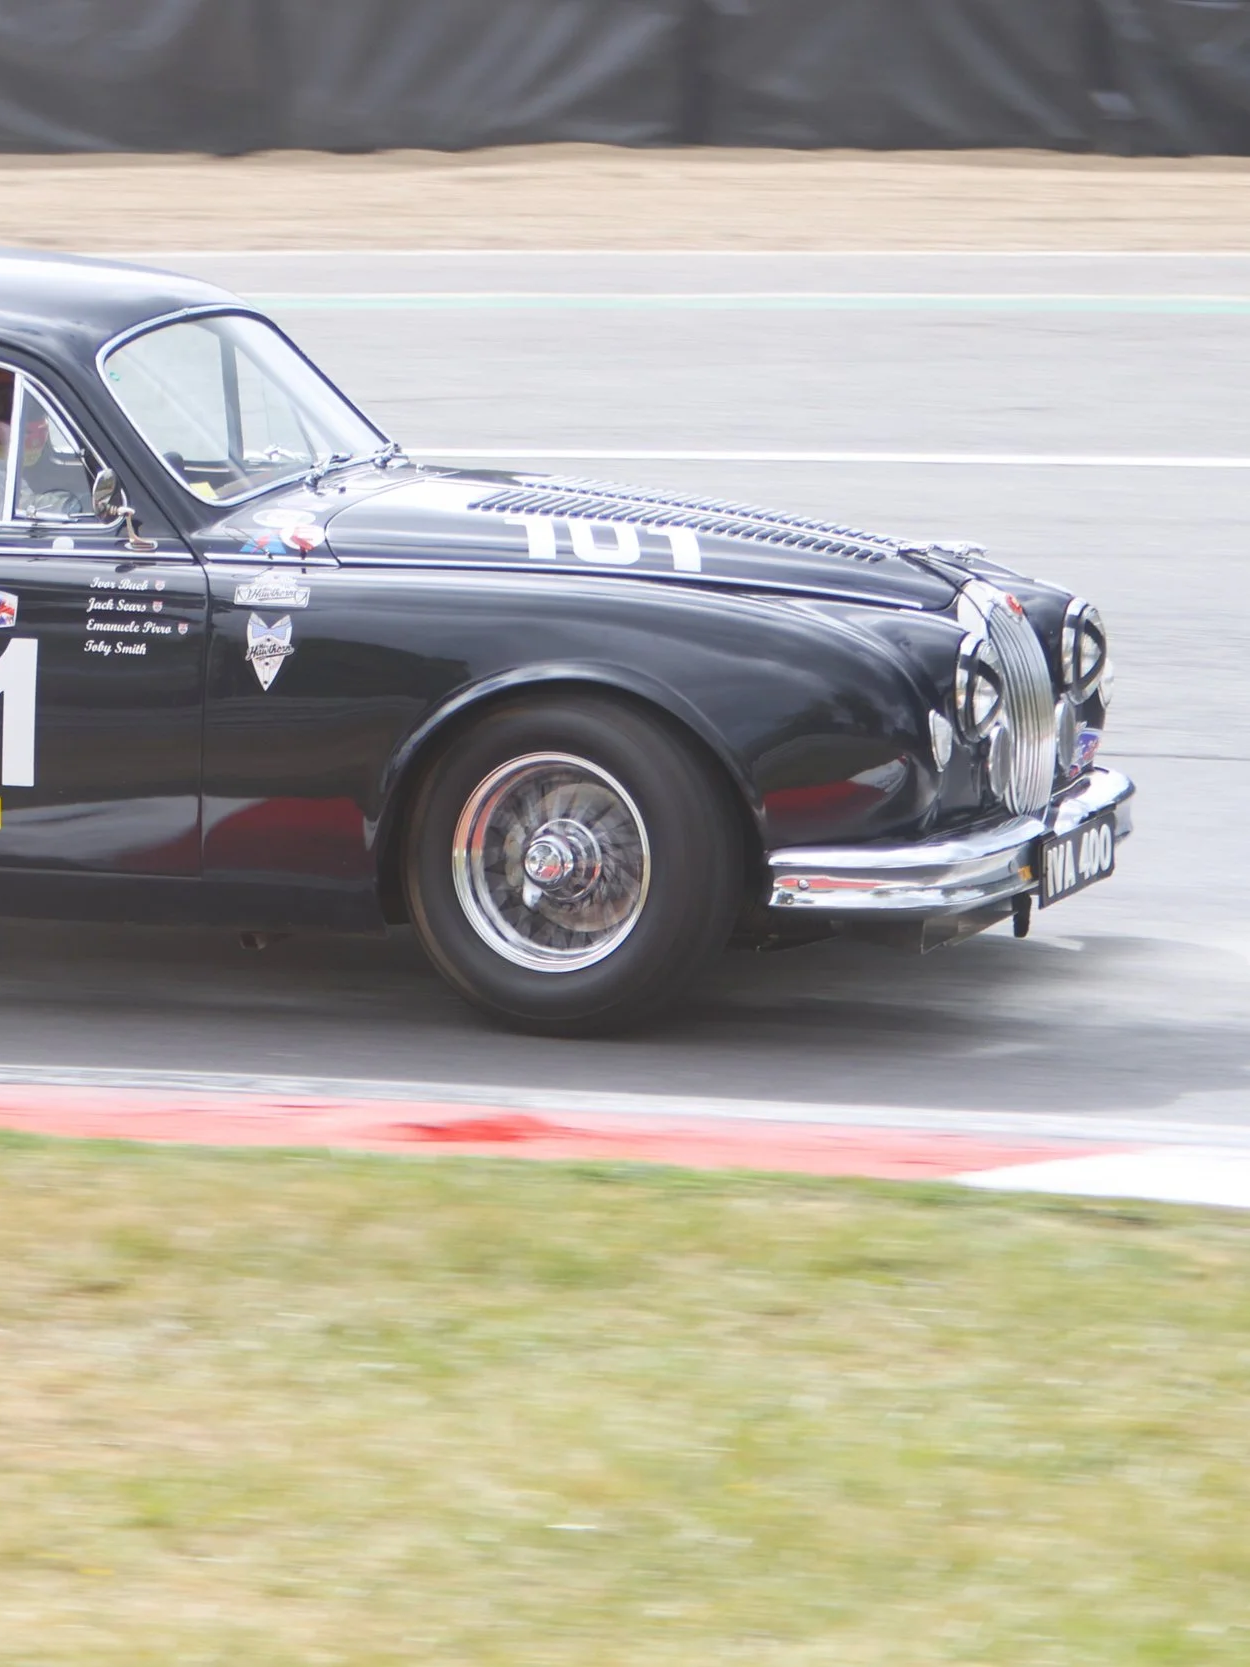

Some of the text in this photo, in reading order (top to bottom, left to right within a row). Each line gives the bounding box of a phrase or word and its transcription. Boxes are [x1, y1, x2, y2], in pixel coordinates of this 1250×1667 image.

[504, 517, 701, 573] 101
[90, 577, 116, 588] Ivor
[86, 597, 147, 612] Jack Sears
[86, 618, 172, 634] Emanuele Pirro
[84, 640, 147, 656] Toby Smith
[1078, 823, 1112, 880] 400
